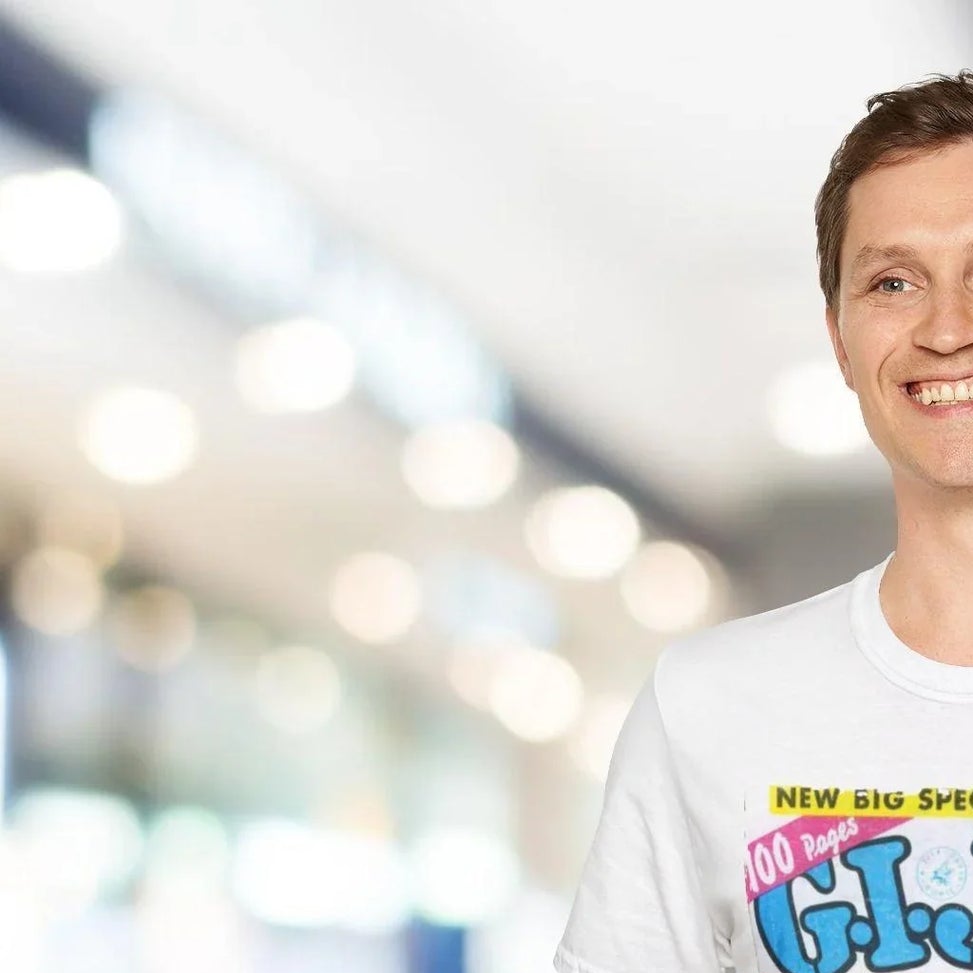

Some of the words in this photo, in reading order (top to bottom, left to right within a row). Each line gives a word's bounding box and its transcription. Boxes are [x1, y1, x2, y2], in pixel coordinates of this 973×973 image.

[776, 787, 840, 809] NEW
[854, 789, 905, 810] BIG
[747, 832, 795, 893] 100
[800, 817, 859, 861] Pages
